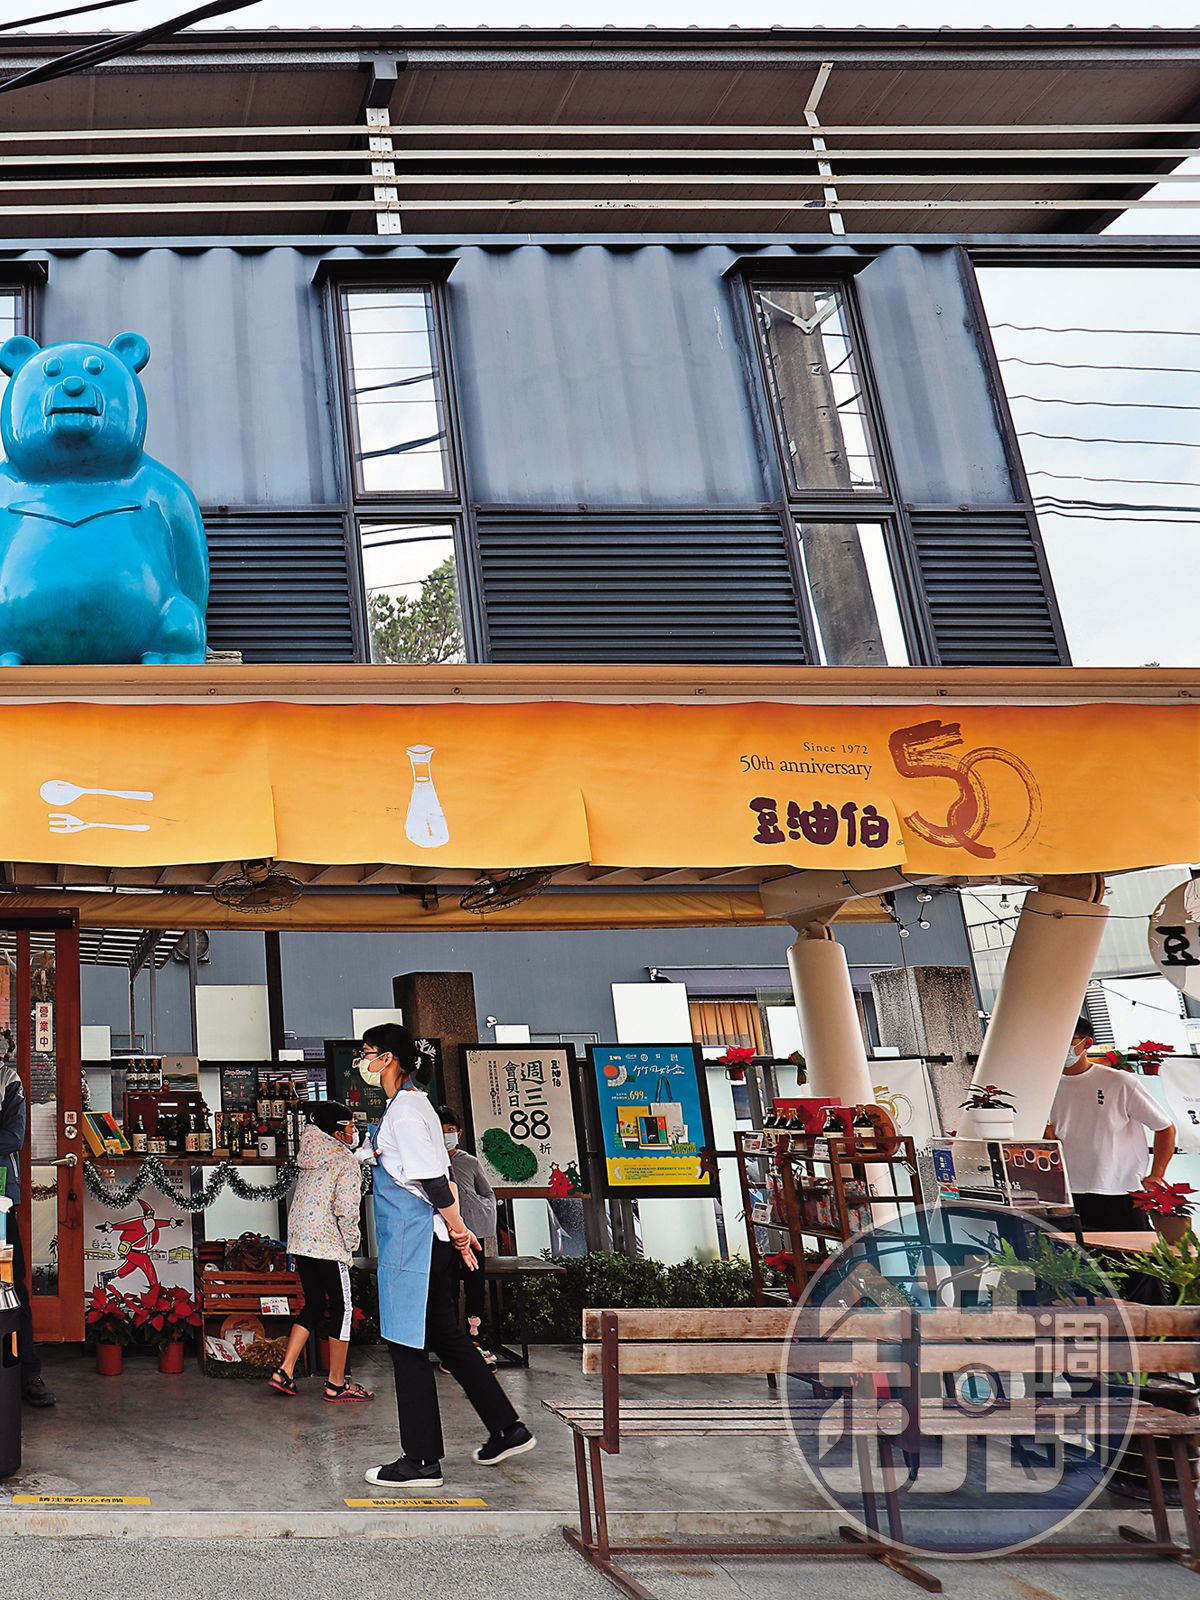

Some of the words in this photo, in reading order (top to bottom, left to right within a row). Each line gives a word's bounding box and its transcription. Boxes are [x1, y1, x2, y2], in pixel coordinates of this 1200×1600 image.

[803, 741, 837, 754] Since
[841, 743, 869, 755] 1972
[739, 755, 776, 774] 50th
[779, 758, 873, 780] anniversary
[749, 797, 890, 848] 豆油伯
[39, 1005, 49, 1048] 營業中
[502, 1060, 521, 1108] 會員日
[520, 1059, 548, 1107] 週三
[509, 1109, 551, 1140] 88
[538, 1142, 552, 1155] 折
